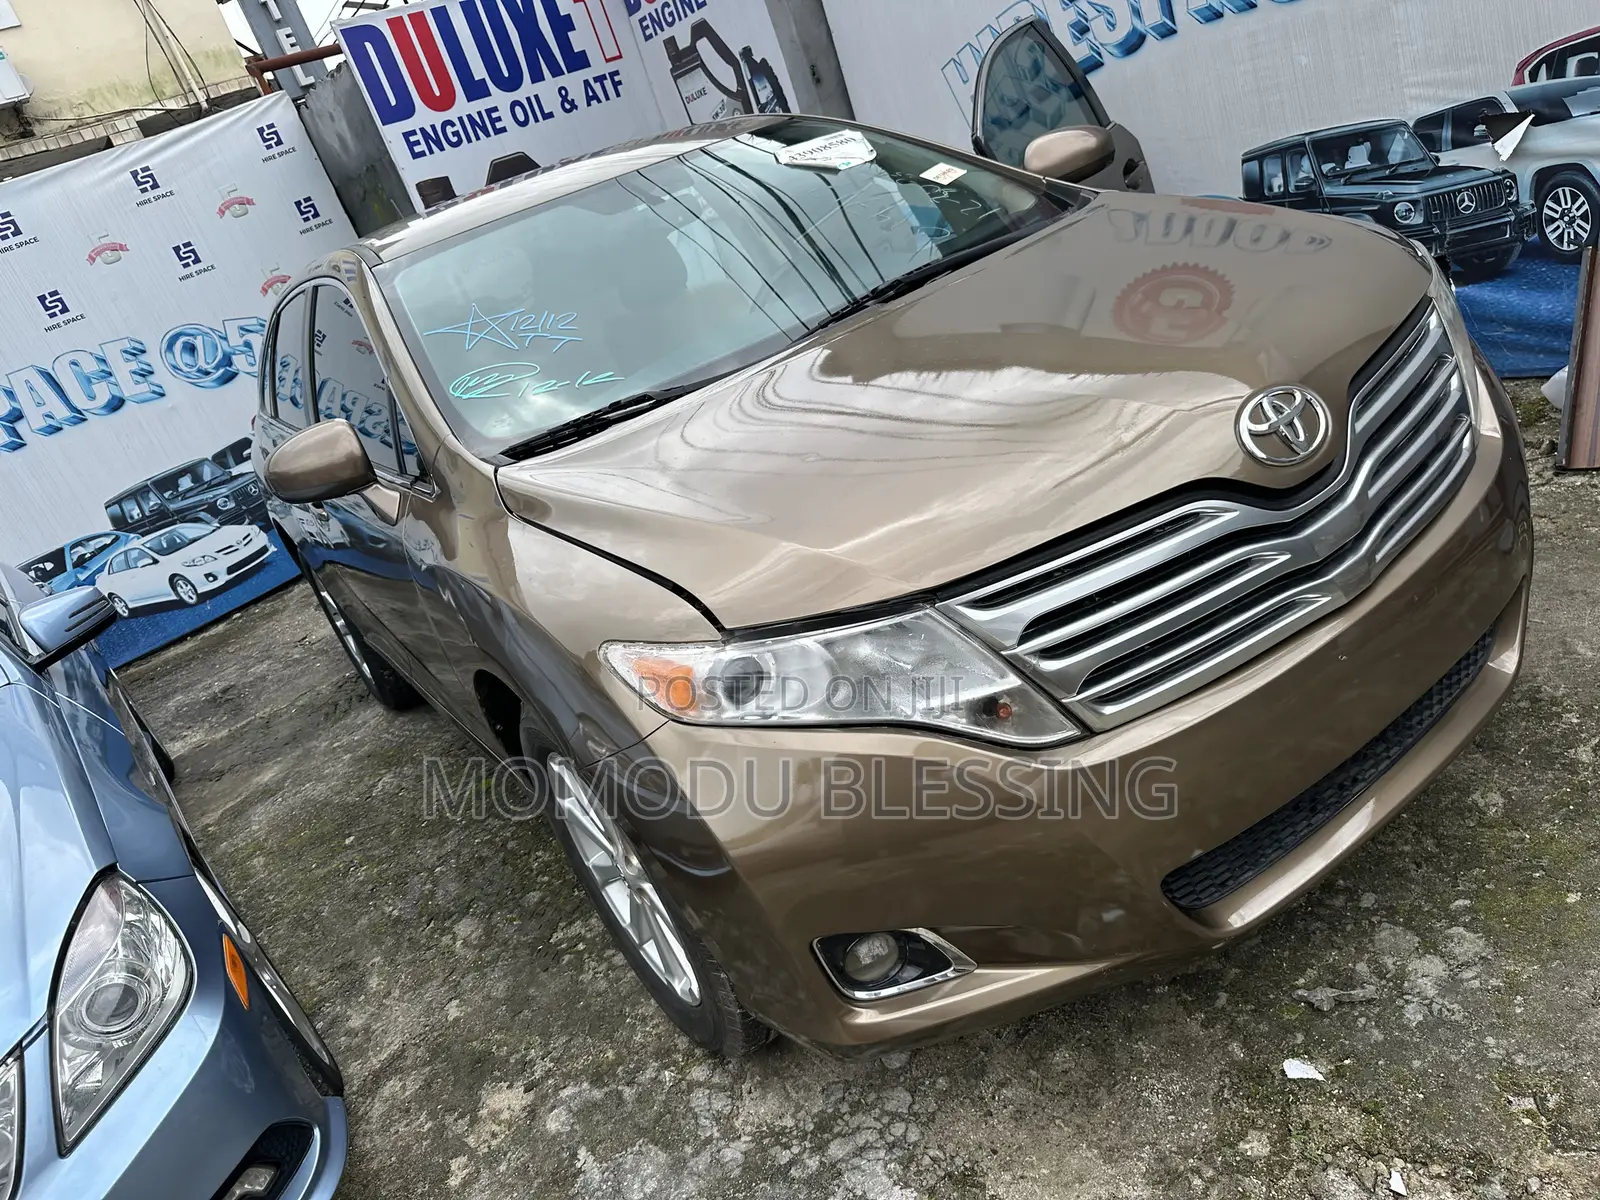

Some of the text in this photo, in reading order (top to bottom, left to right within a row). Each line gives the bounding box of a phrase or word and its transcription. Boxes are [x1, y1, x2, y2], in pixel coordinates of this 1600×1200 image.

[638, 0, 708, 42] ENGINE
[340, 0, 591, 126] DULUXE
[402, 70, 623, 160] ENGINE OIL & ATF
[261, 146, 297, 163] HIRE SPACE
[136, 190, 175, 207] HIRE SPACE
[299, 218, 333, 235] HIRE SPACE
[15, 236, 39, 249] SPACE
[178, 264, 216, 282] HIRE SPACE
[44, 313, 86, 333] HIRE SPACE
